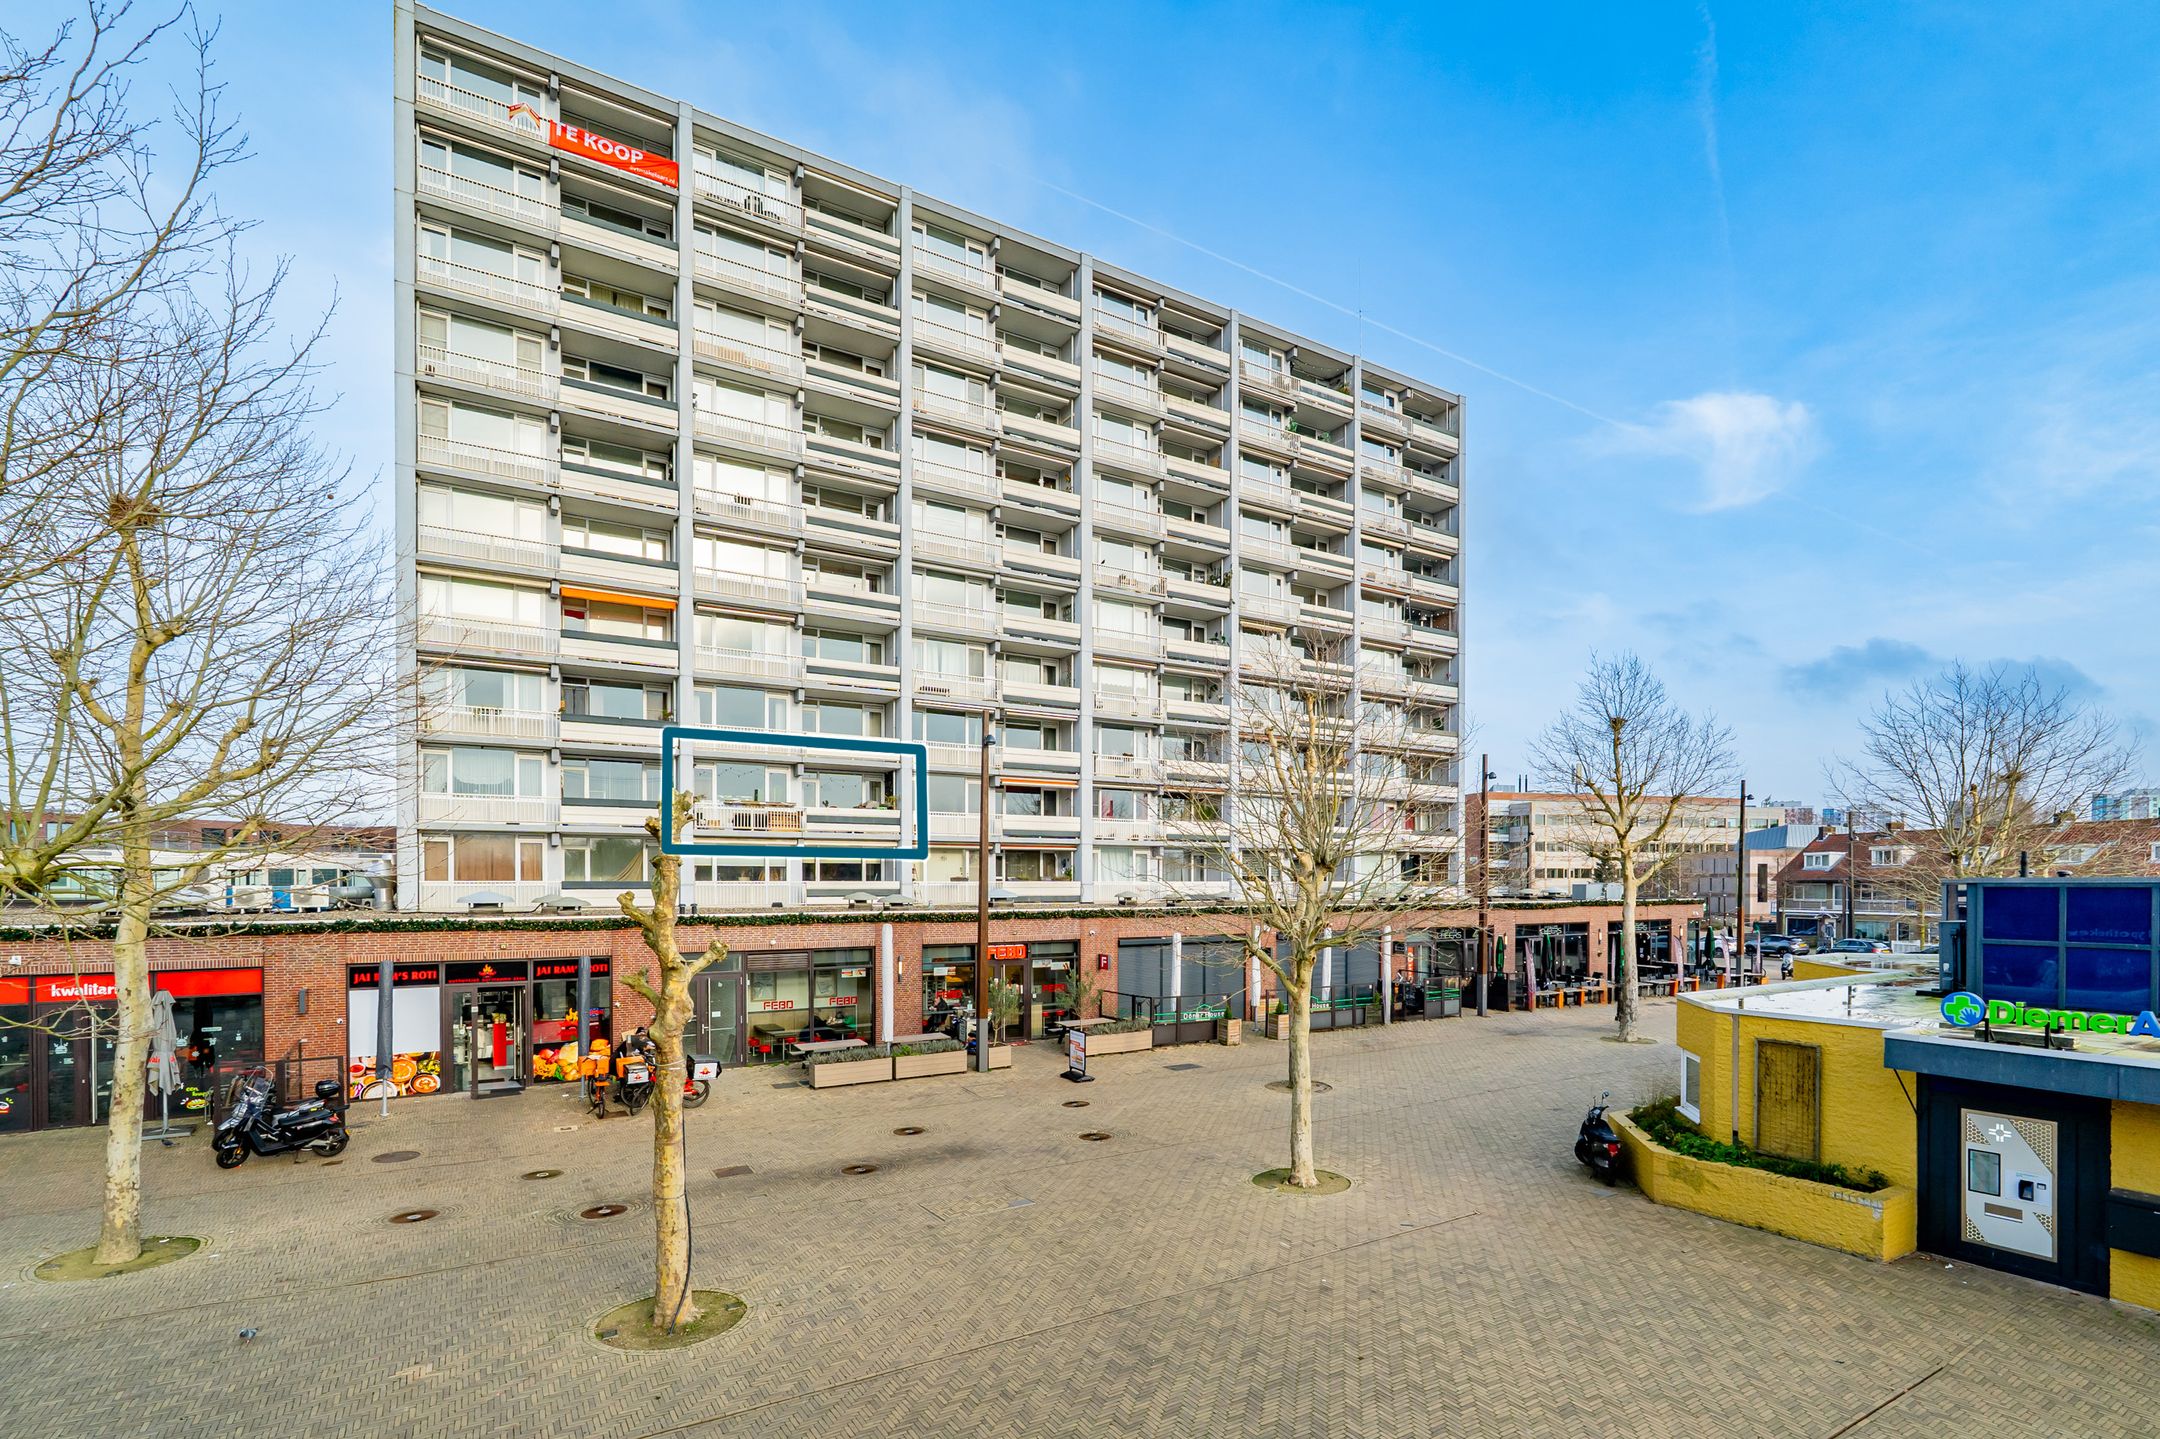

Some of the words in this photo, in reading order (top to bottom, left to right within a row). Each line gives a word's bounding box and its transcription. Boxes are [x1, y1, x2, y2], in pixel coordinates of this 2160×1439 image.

[555, 121, 578, 143] TE
[584, 133, 643, 163] KOOP
[987, 944, 1027, 960] FEBO
[1101, 956, 1107, 967] F
[353, 973, 371, 985] JAI
[411, 969, 437, 980] ROTI
[536, 966, 551, 977] JAI
[763, 1000, 794, 1010] FEBO
[829, 996, 858, 1006] FEBO
[1988, 1000, 2160, 1038] DiemerA
